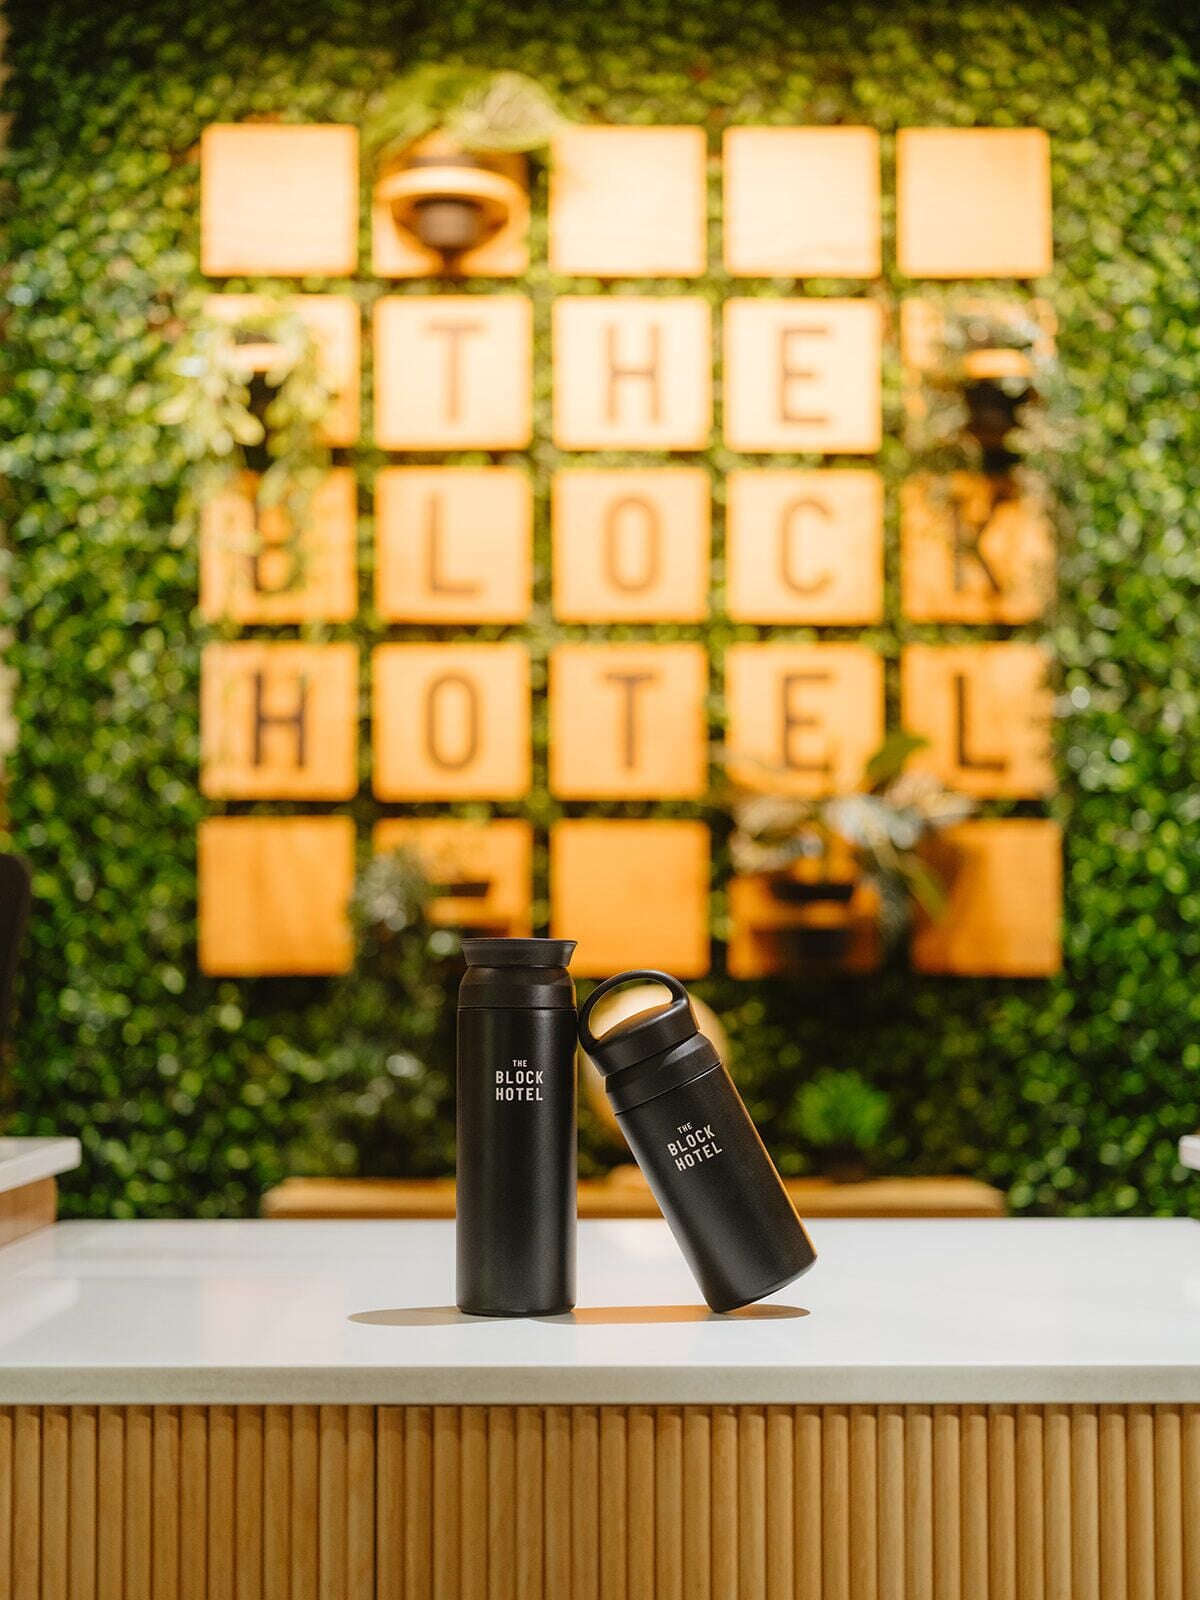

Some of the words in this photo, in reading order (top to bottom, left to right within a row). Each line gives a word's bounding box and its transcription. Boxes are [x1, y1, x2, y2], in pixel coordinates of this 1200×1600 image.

[425, 321, 830, 426] THE
[252, 671, 1008, 773] HOTEL
[512, 1059, 528, 1068] THE
[495, 1070, 544, 1085] BLOCK
[495, 1087, 544, 1101] HOTEL
[676, 1121, 694, 1135] THE
[666, 1124, 716, 1157] BLOCK
[674, 1141, 723, 1172] HOTEL
